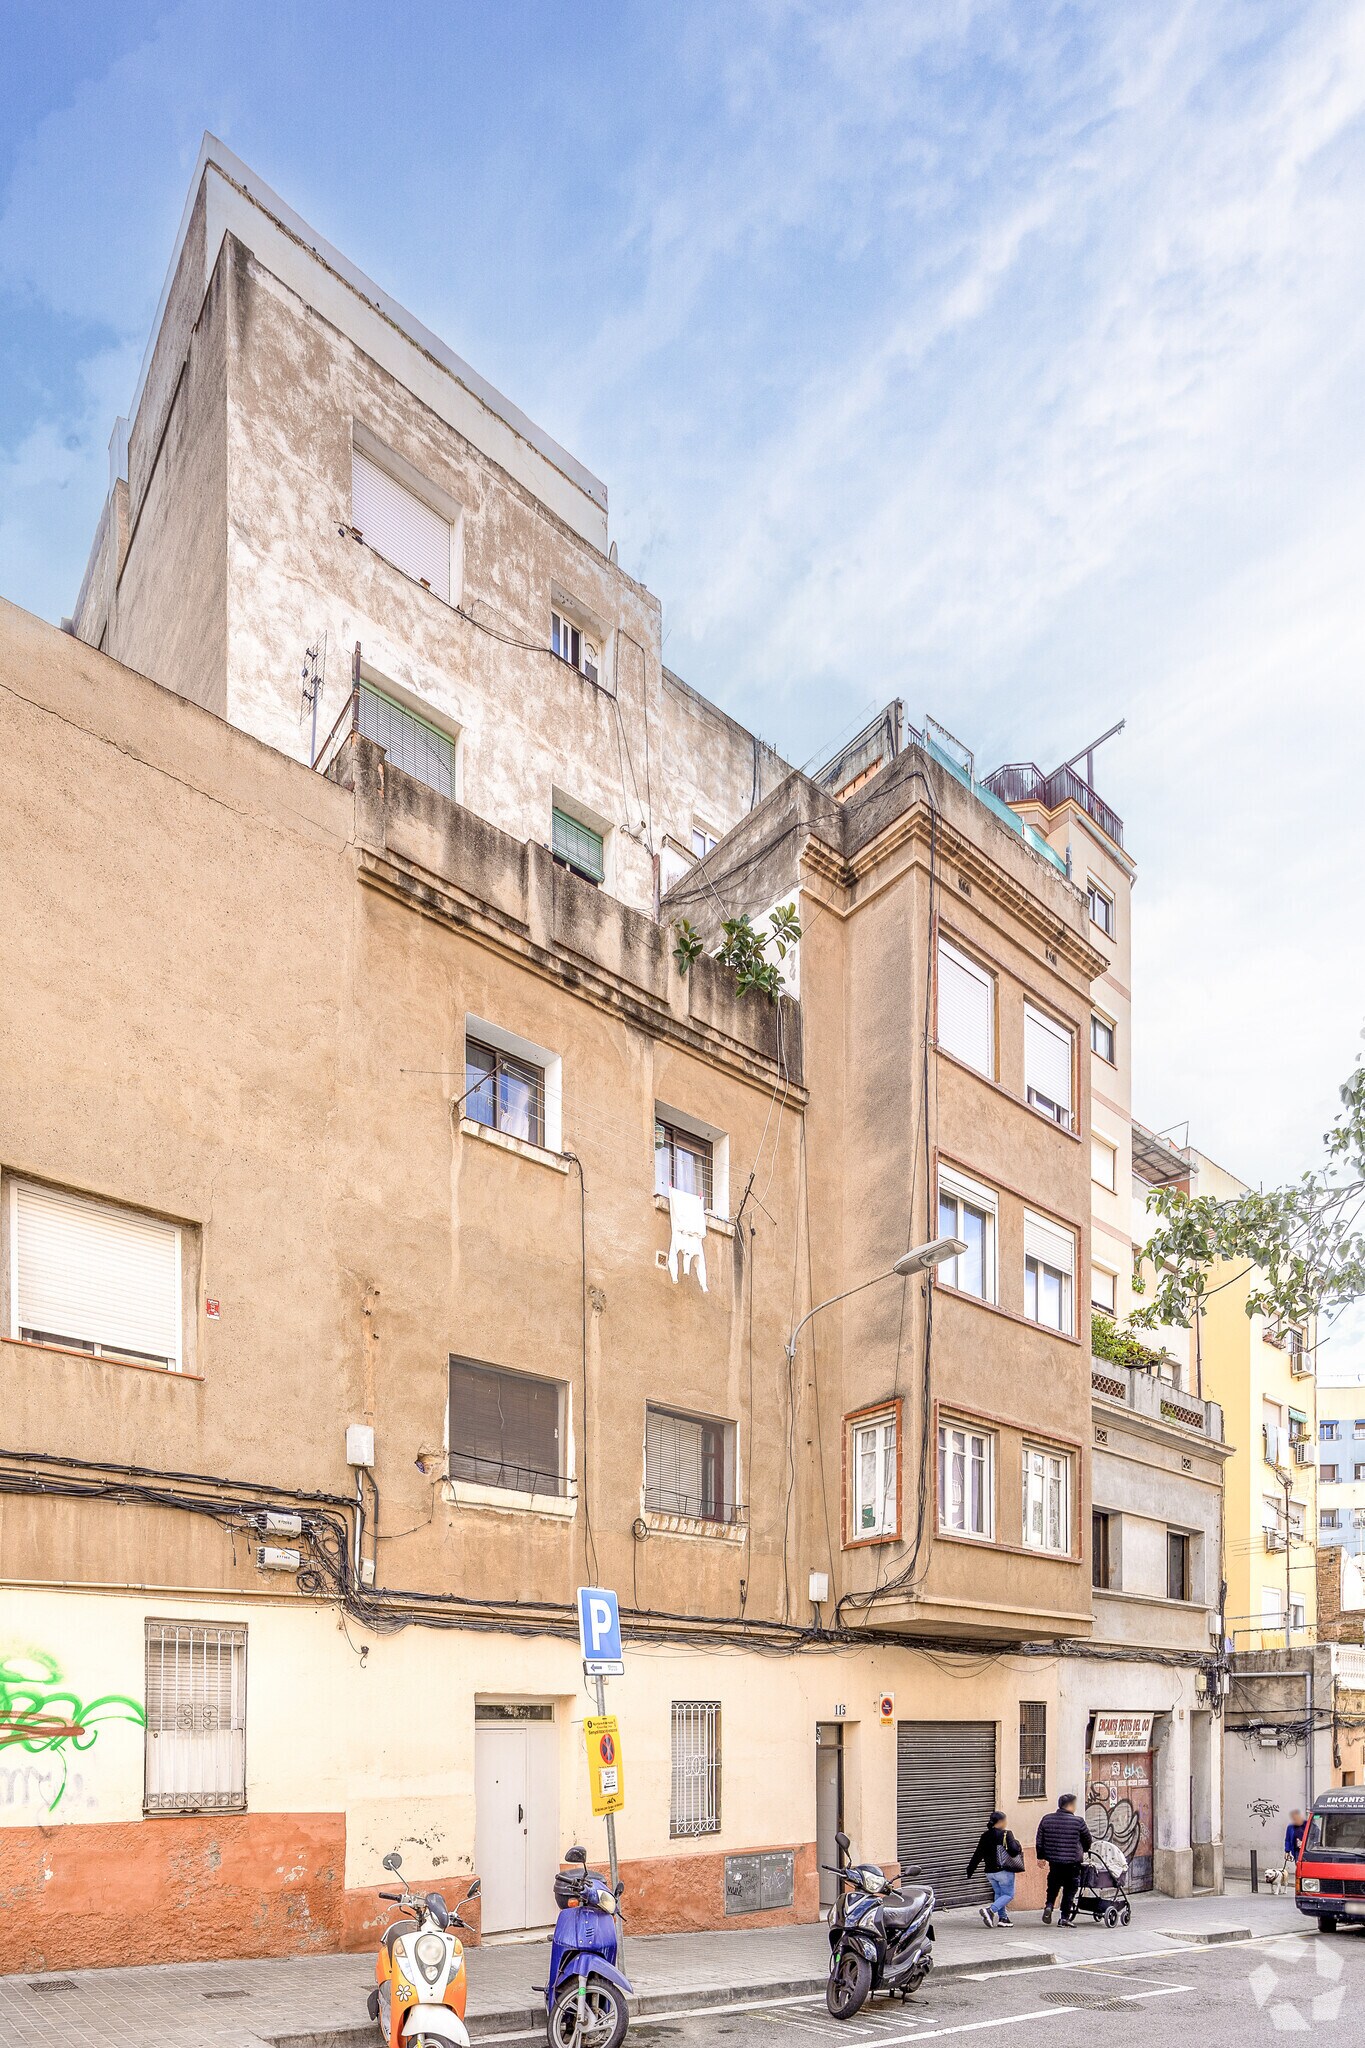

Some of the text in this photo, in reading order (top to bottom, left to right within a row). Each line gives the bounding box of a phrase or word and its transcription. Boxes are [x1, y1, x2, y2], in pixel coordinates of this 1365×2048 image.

[590, 1598, 612, 1651] P
[835, 1704, 846, 1715] 115
[1098, 1719, 1150, 1731] ENCANTS PETITS DEL OCI
